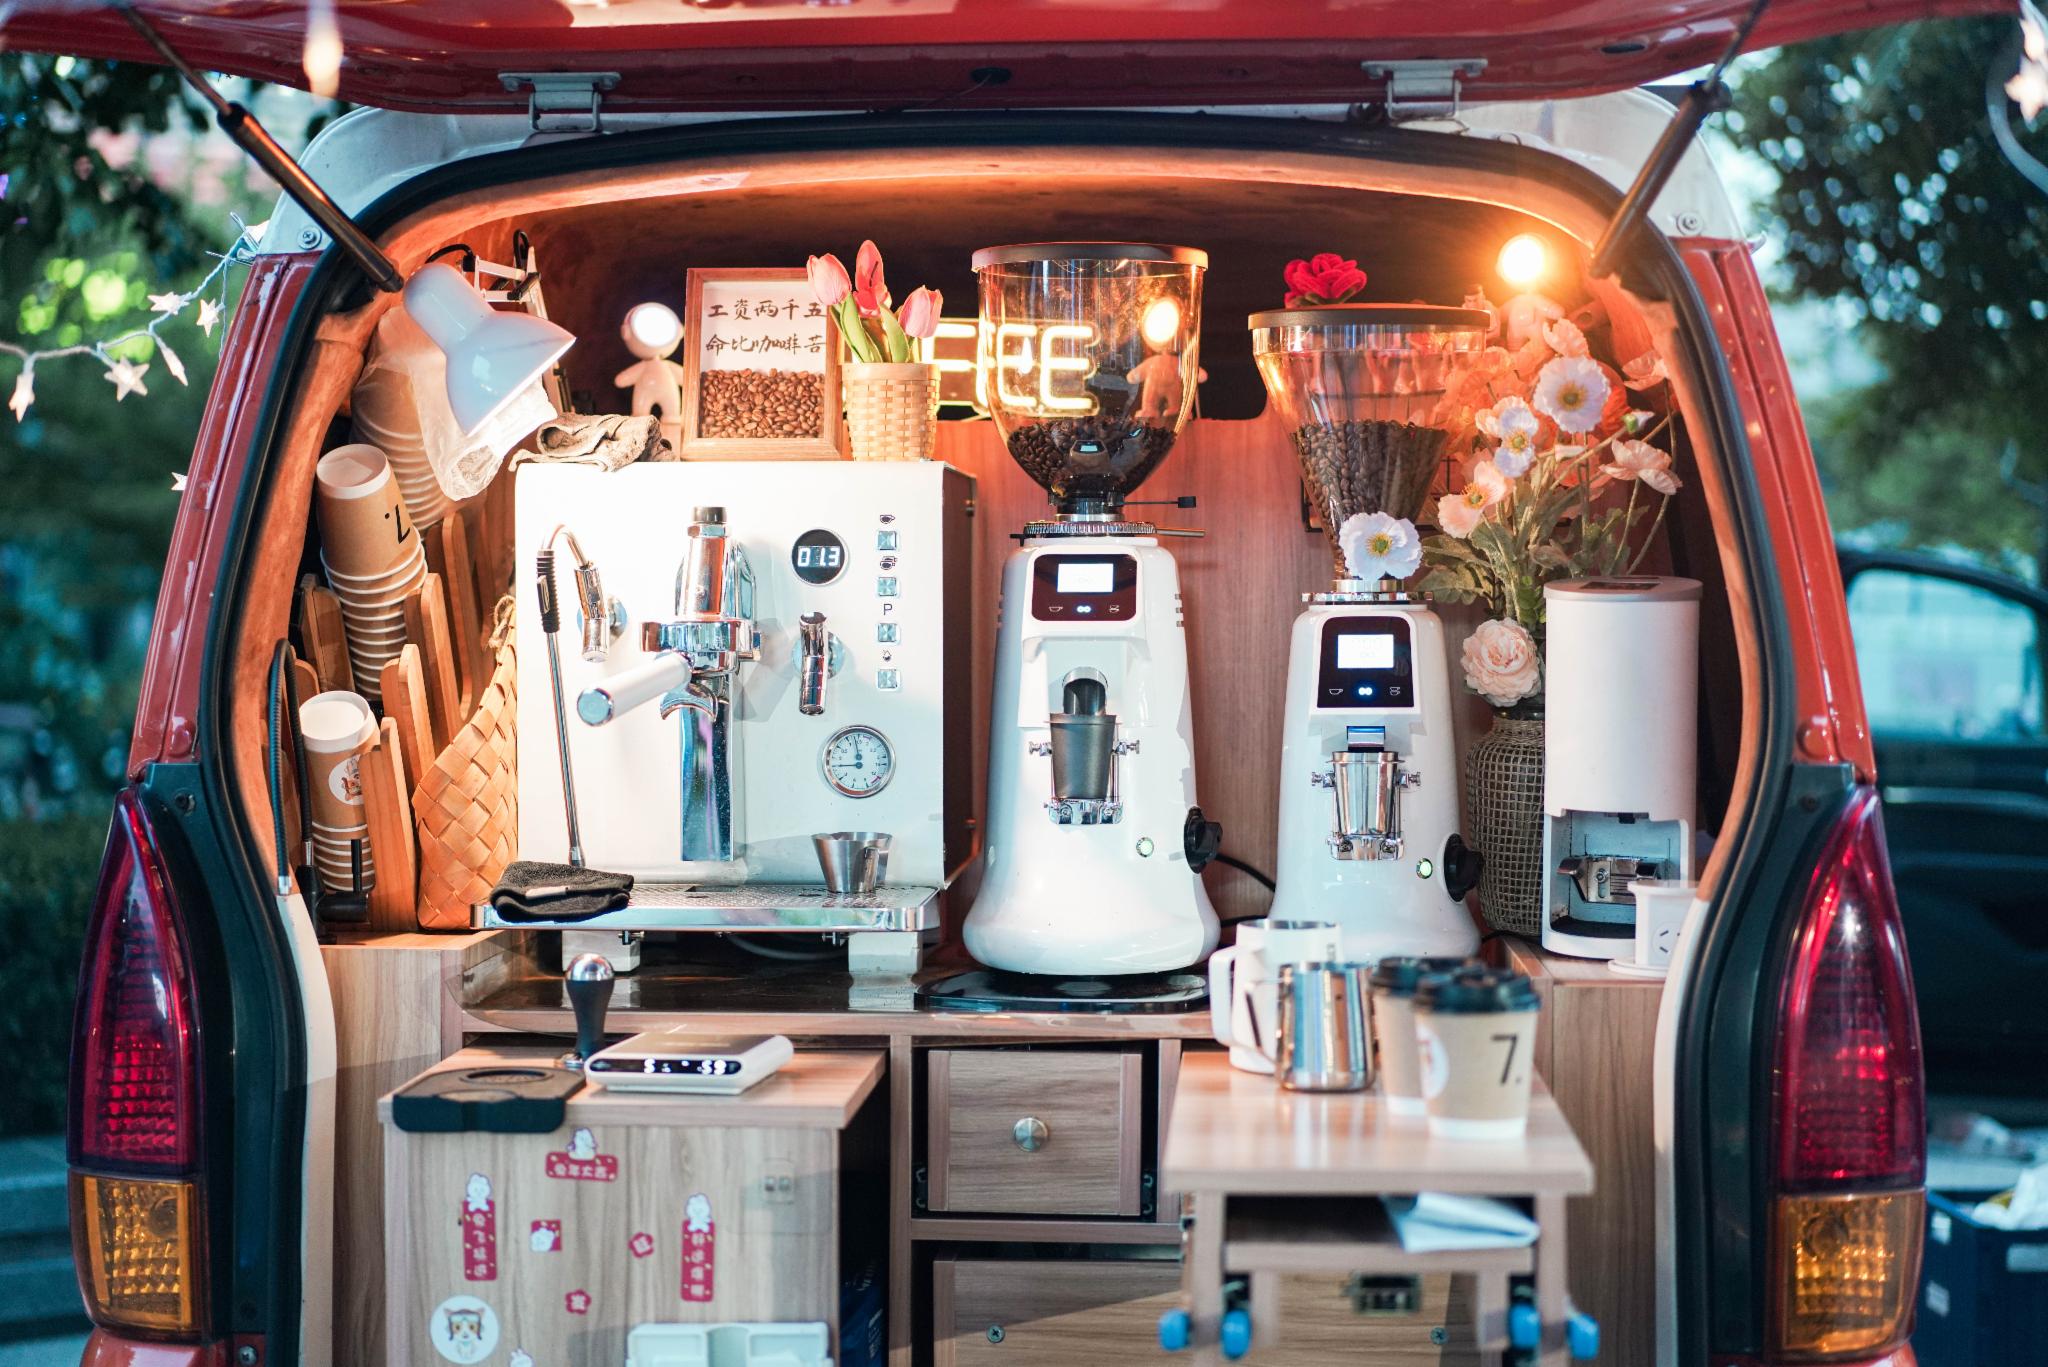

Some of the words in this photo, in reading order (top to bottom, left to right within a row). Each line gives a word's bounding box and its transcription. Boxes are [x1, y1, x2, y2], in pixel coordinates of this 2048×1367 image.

[708, 299, 826, 321] 工资两千五
[706, 333, 826, 356] 命比咖啡苦
[883, 603, 893, 616] P
